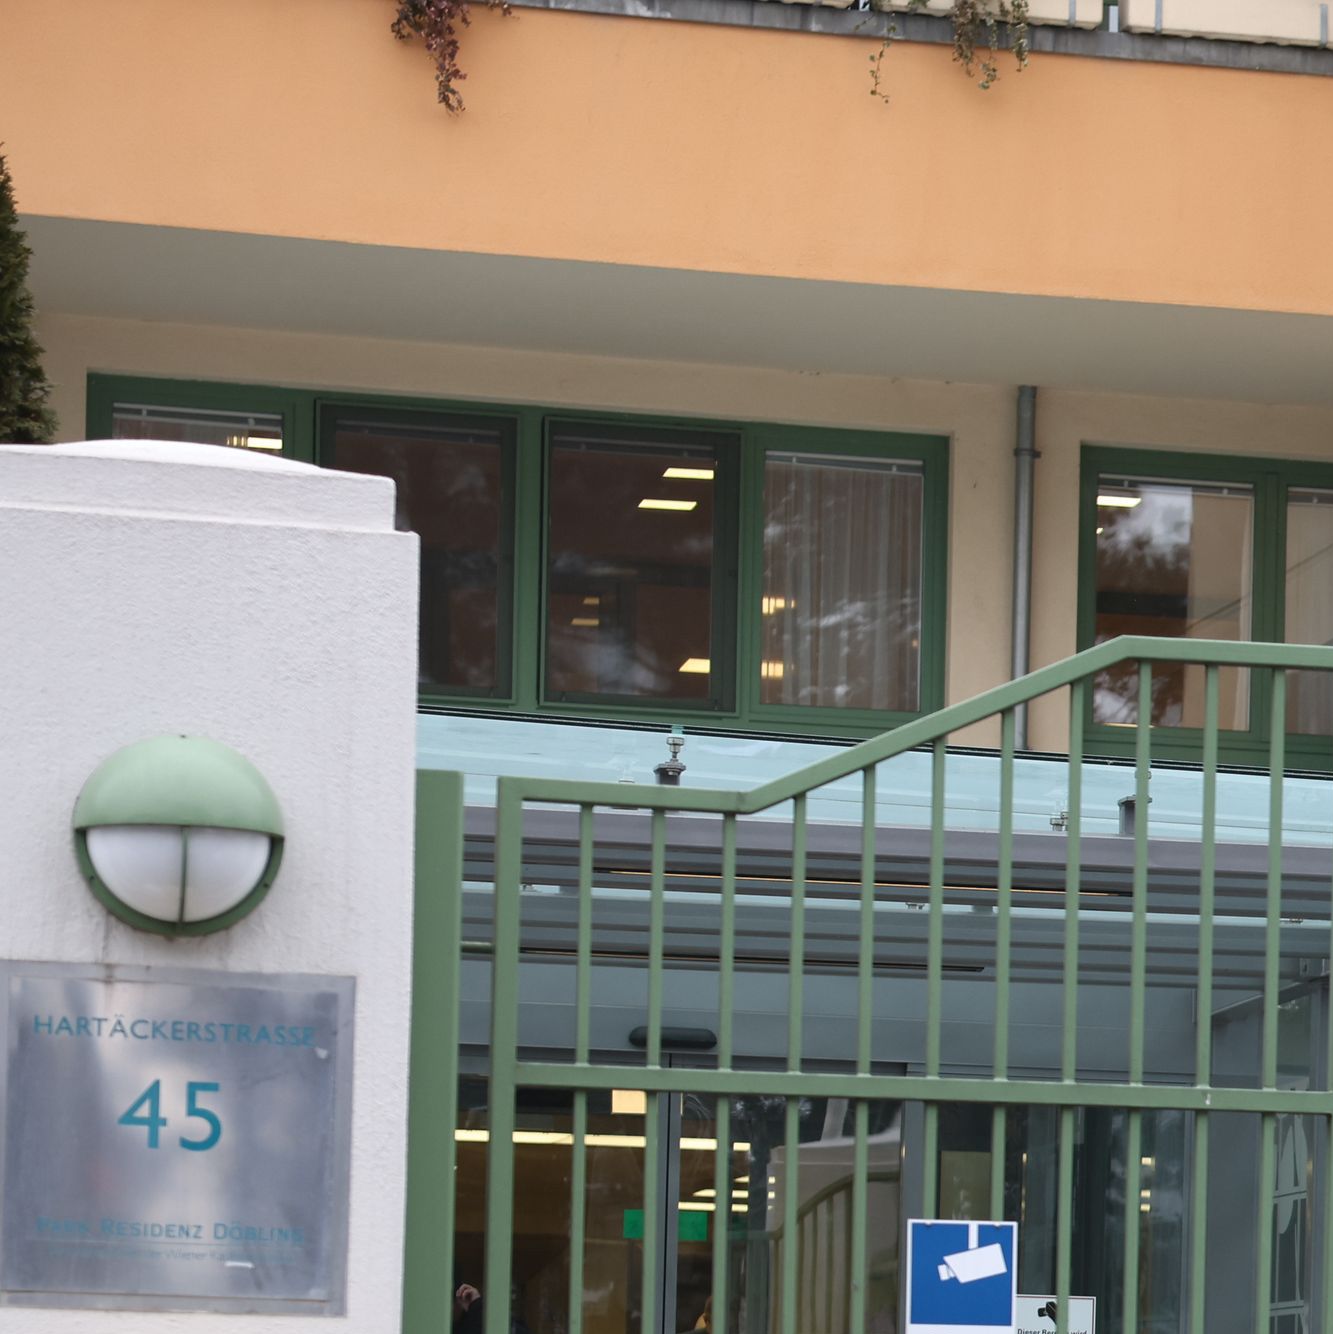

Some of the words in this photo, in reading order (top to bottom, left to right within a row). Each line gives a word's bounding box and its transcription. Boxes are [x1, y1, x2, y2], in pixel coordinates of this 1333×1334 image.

[32, 1013, 317, 1047] HARTÄCKERSTRASSE
[117, 1079, 222, 1151] 45
[102, 1218, 204, 1240] RESIDENZ
